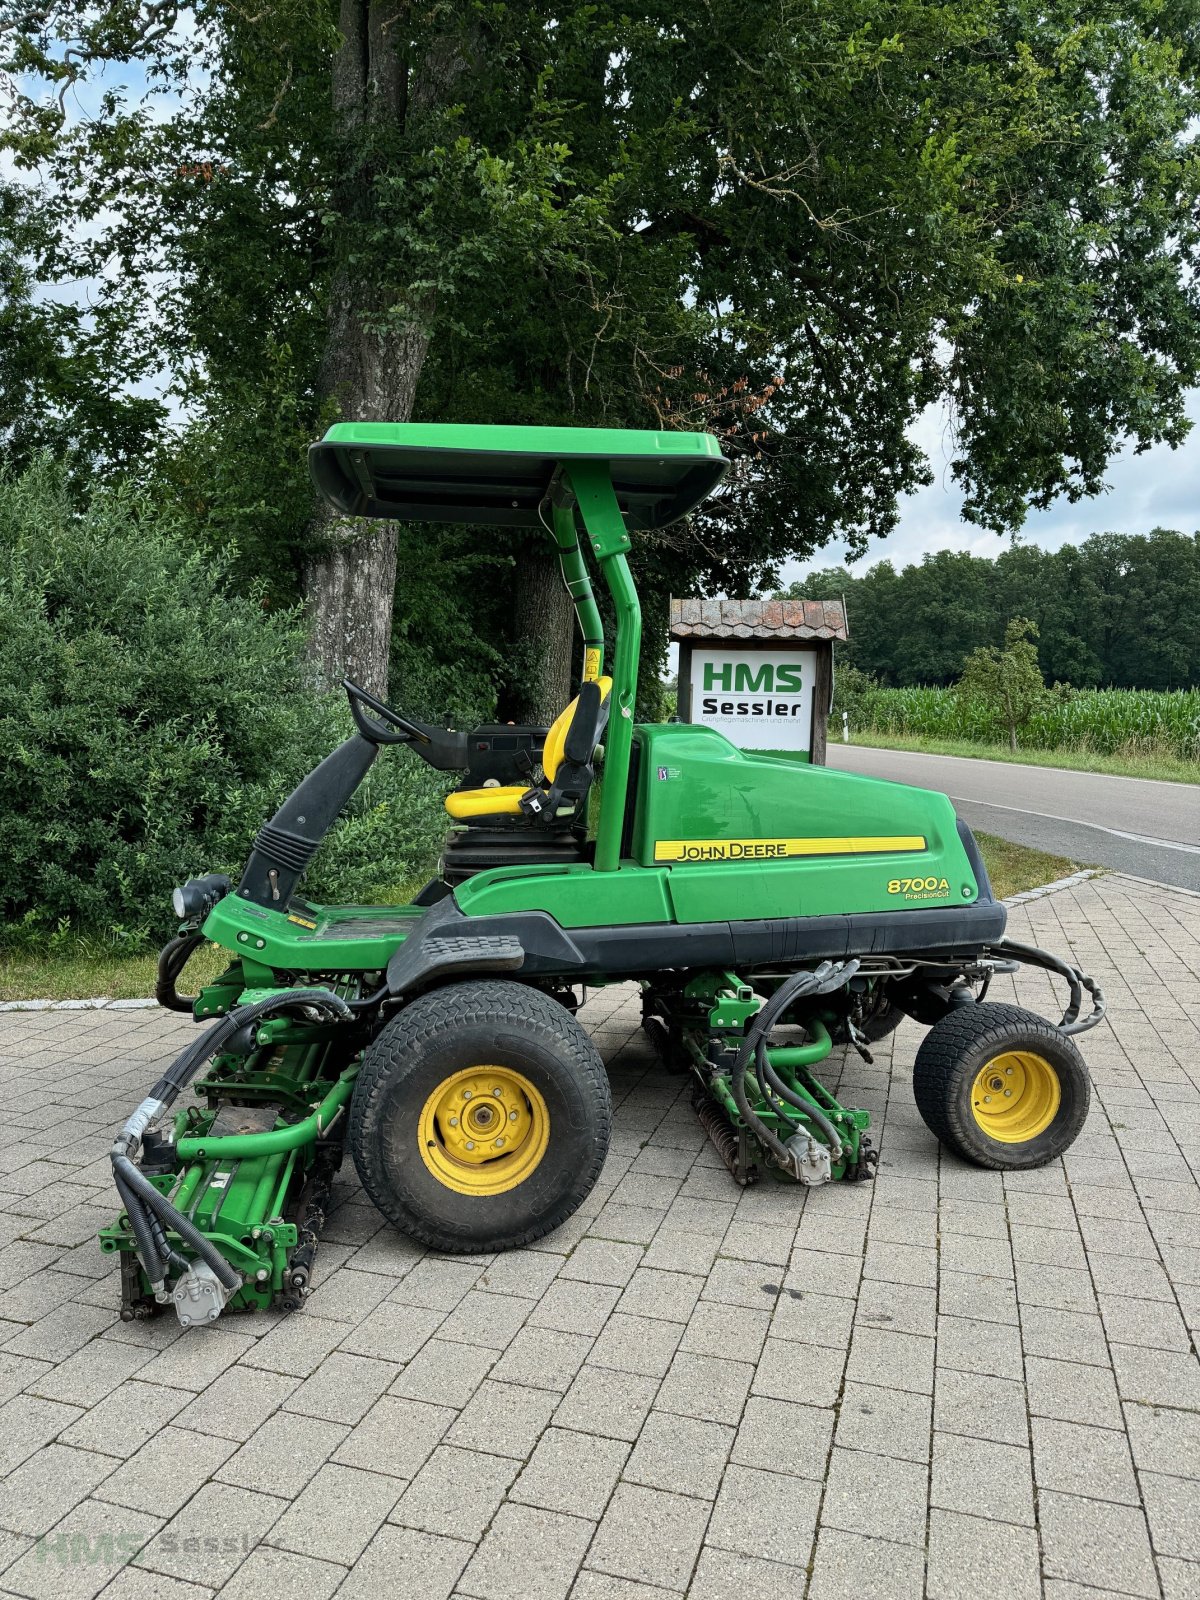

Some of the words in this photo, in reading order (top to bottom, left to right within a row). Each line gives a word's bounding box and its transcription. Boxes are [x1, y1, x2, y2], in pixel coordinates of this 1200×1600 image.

[703, 663, 802, 692] HMS
[703, 699, 801, 716] Sessler
[677, 845, 725, 860] JOHN
[729, 843, 787, 857] DEERE
[905, 890, 950, 900] PrecisionCut
